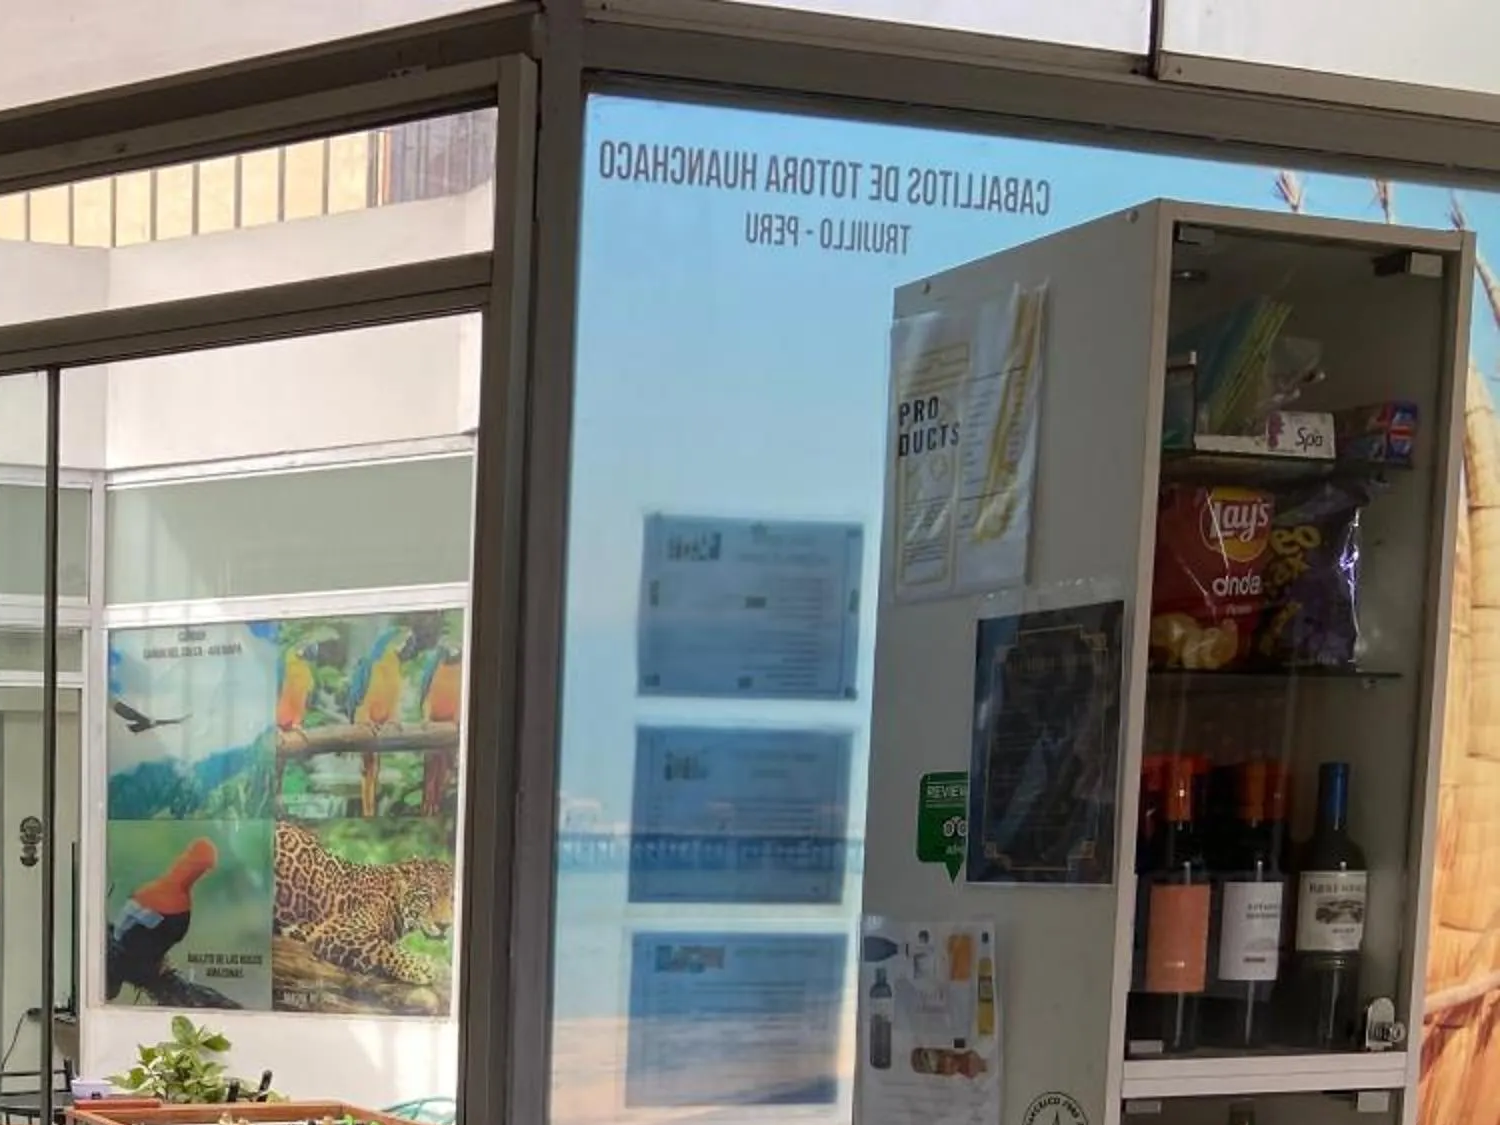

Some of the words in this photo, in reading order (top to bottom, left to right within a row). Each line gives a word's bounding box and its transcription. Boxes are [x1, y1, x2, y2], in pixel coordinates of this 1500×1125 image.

[899, 395, 940, 427] PRO
[898, 422, 961, 458] DUCTS
[1209, 497, 1271, 543] Lay's
